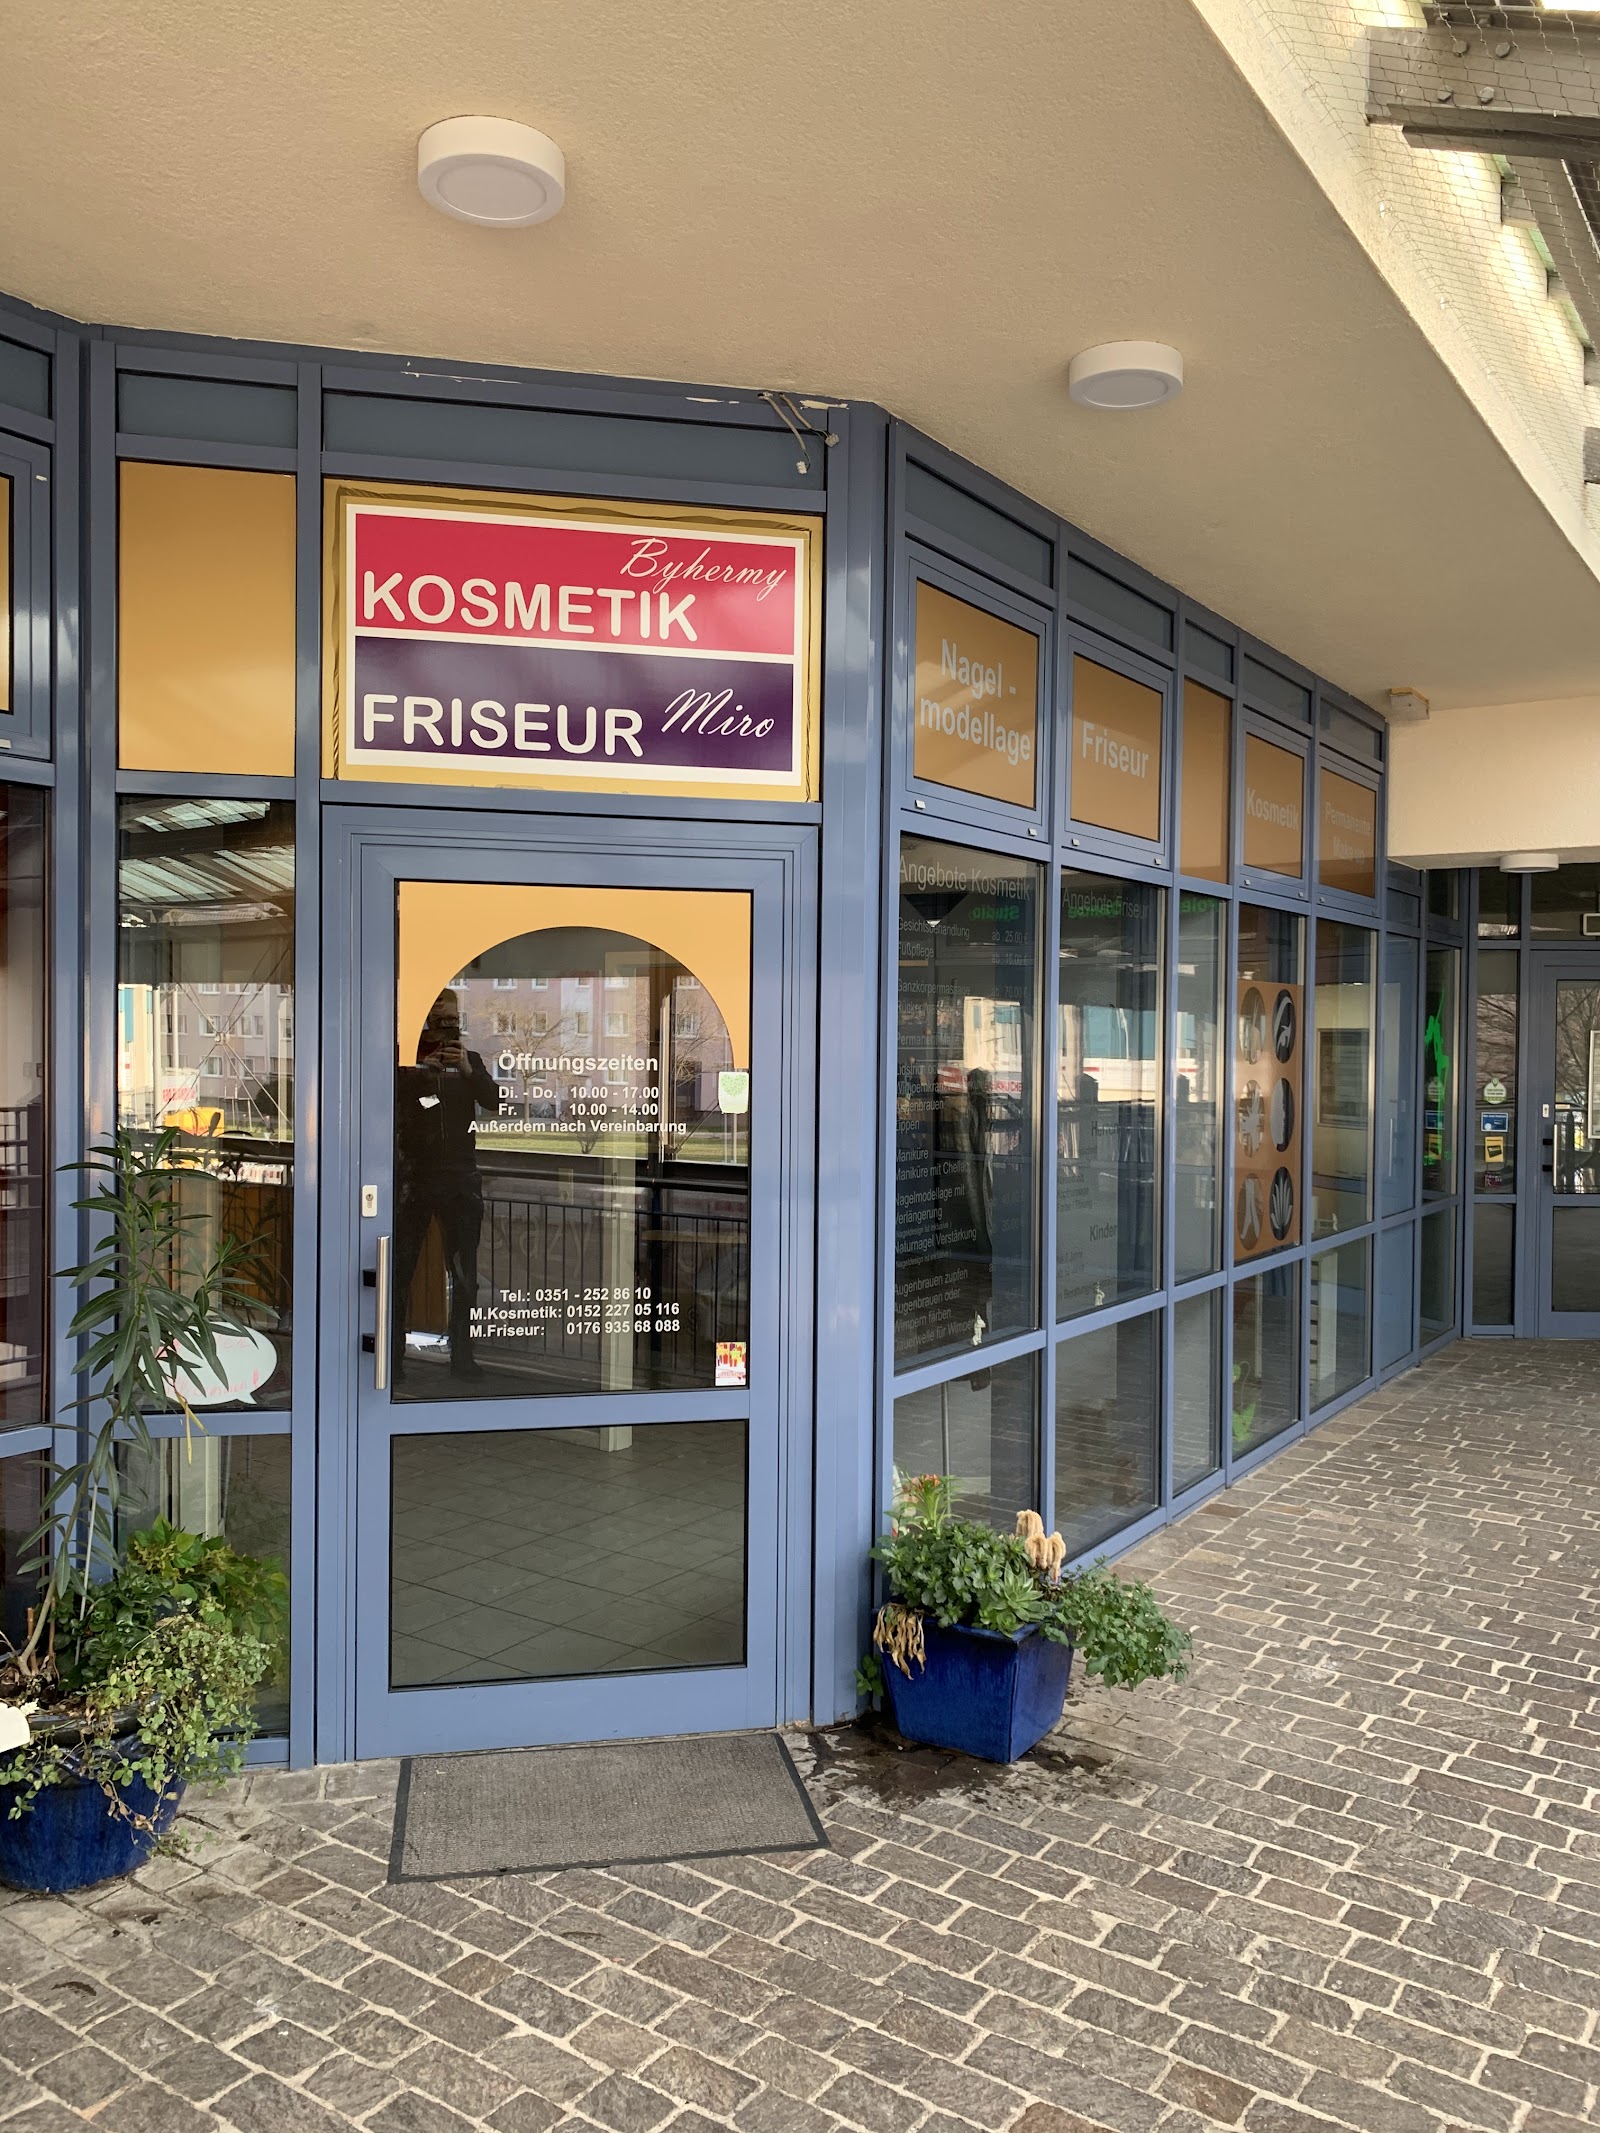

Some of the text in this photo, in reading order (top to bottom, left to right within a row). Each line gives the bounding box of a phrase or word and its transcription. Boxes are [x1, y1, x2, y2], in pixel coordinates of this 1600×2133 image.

[620, 538, 787, 601] Byhermy
[363, 570, 698, 642] KOSMETIK
[942, 638, 1002, 698] Nagel
[363, 689, 775, 757] FRISEUR Miro
[920, 696, 1031, 766] modellage
[1082, 719, 1149, 780] Friseur
[1246, 787, 1300, 832] Kosmetik
[899, 855, 1030, 900] Angebote Kosmetik
[498, 1050, 658, 1075] Öffnungszeiten
[498, 1086, 518, 1099] Di.
[533, 1086, 556, 1099] Do.
[570, 1086, 608, 1099] 10.00
[622, 1086, 659, 1099] 17.00
[498, 1103, 517, 1116] Fr.
[569, 1103, 607, 1116] 10.00
[621, 1103, 658, 1116] 14.00
[467, 1120, 687, 1135] Außerdem nach Vereinbarung
[930, 1163, 941, 1176] mit
[954, 1184, 965, 1197] mit
[936, 1228, 977, 1244] Verstärkung
[1089, 1223, 1118, 1241] Kinder
[895, 1275, 943, 1297] Augenbrauen
[945, 1268, 968, 1286] zupfen
[500, 1289, 530, 1302] Tel.:
[535, 1288, 568, 1301] 0351
[584, 1288, 609, 1301] 252
[613, 1288, 630, 1300] 86
[635, 1287, 651, 1300] 10
[945, 1288, 960, 1302] oder
[470, 1303, 680, 1321] M.Kosmetik: 0152 227 05 116
[470, 1320, 680, 1337] M.Friseur: 0176 935 68 088
